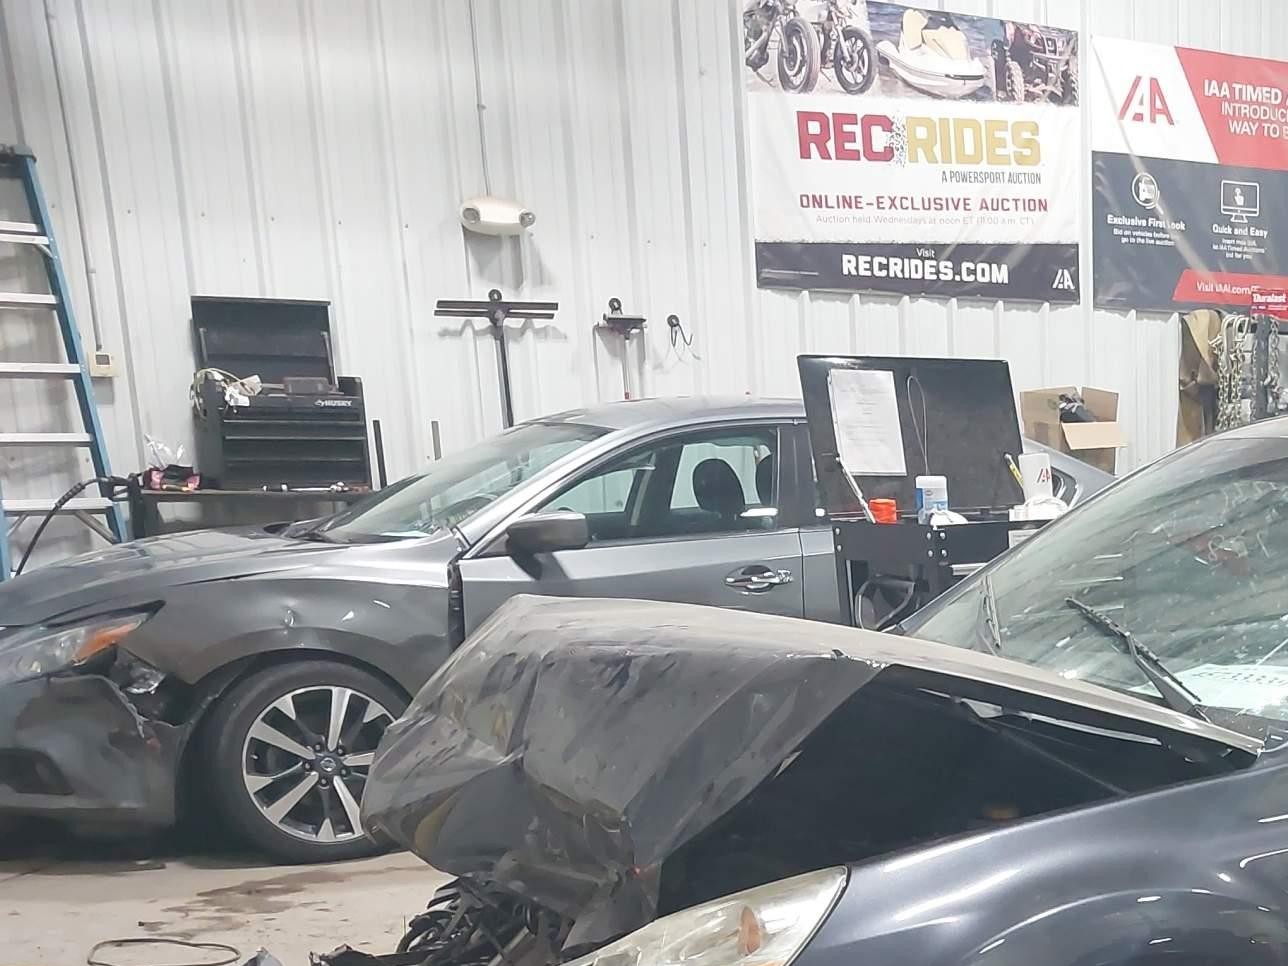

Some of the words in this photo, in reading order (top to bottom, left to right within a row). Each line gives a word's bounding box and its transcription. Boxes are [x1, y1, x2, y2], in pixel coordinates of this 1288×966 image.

[1204, 79, 1230, 98] IAA
[1232, 83, 1282, 104] TIMED
[1228, 121, 1259, 136] WAY
[1262, 124, 1280, 138] TO
[796, 110, 895, 162] REC
[905, 116, 1042, 166] RIDES
[942, 170, 948, 183] A
[950, 170, 1006, 184] POWERSPORT
[1007, 172, 1042, 184] AUCTION
[800, 194, 971, 212] ONLINE-EXCLUSIVE
[979, 198, 1048, 212] AUCTION
[816, 215, 850, 224] Auction
[852, 215, 872, 224] held
[874, 216, 926, 226] Wednesdays
[963, 216, 974, 224] ET
[1107, 214, 1146, 227] Exclusive
[1148, 218, 1166, 228] First
[1212, 224, 1232, 234] Quick
[1234, 226, 1248, 236] and
[1250, 228, 1268, 238] Easy
[916, 248, 935, 258] Visit
[842, 254, 1008, 284] RECRIDES.COM
[1196, 282, 1214, 292] Visit
[1252, 293, 1286, 303] Duralast
